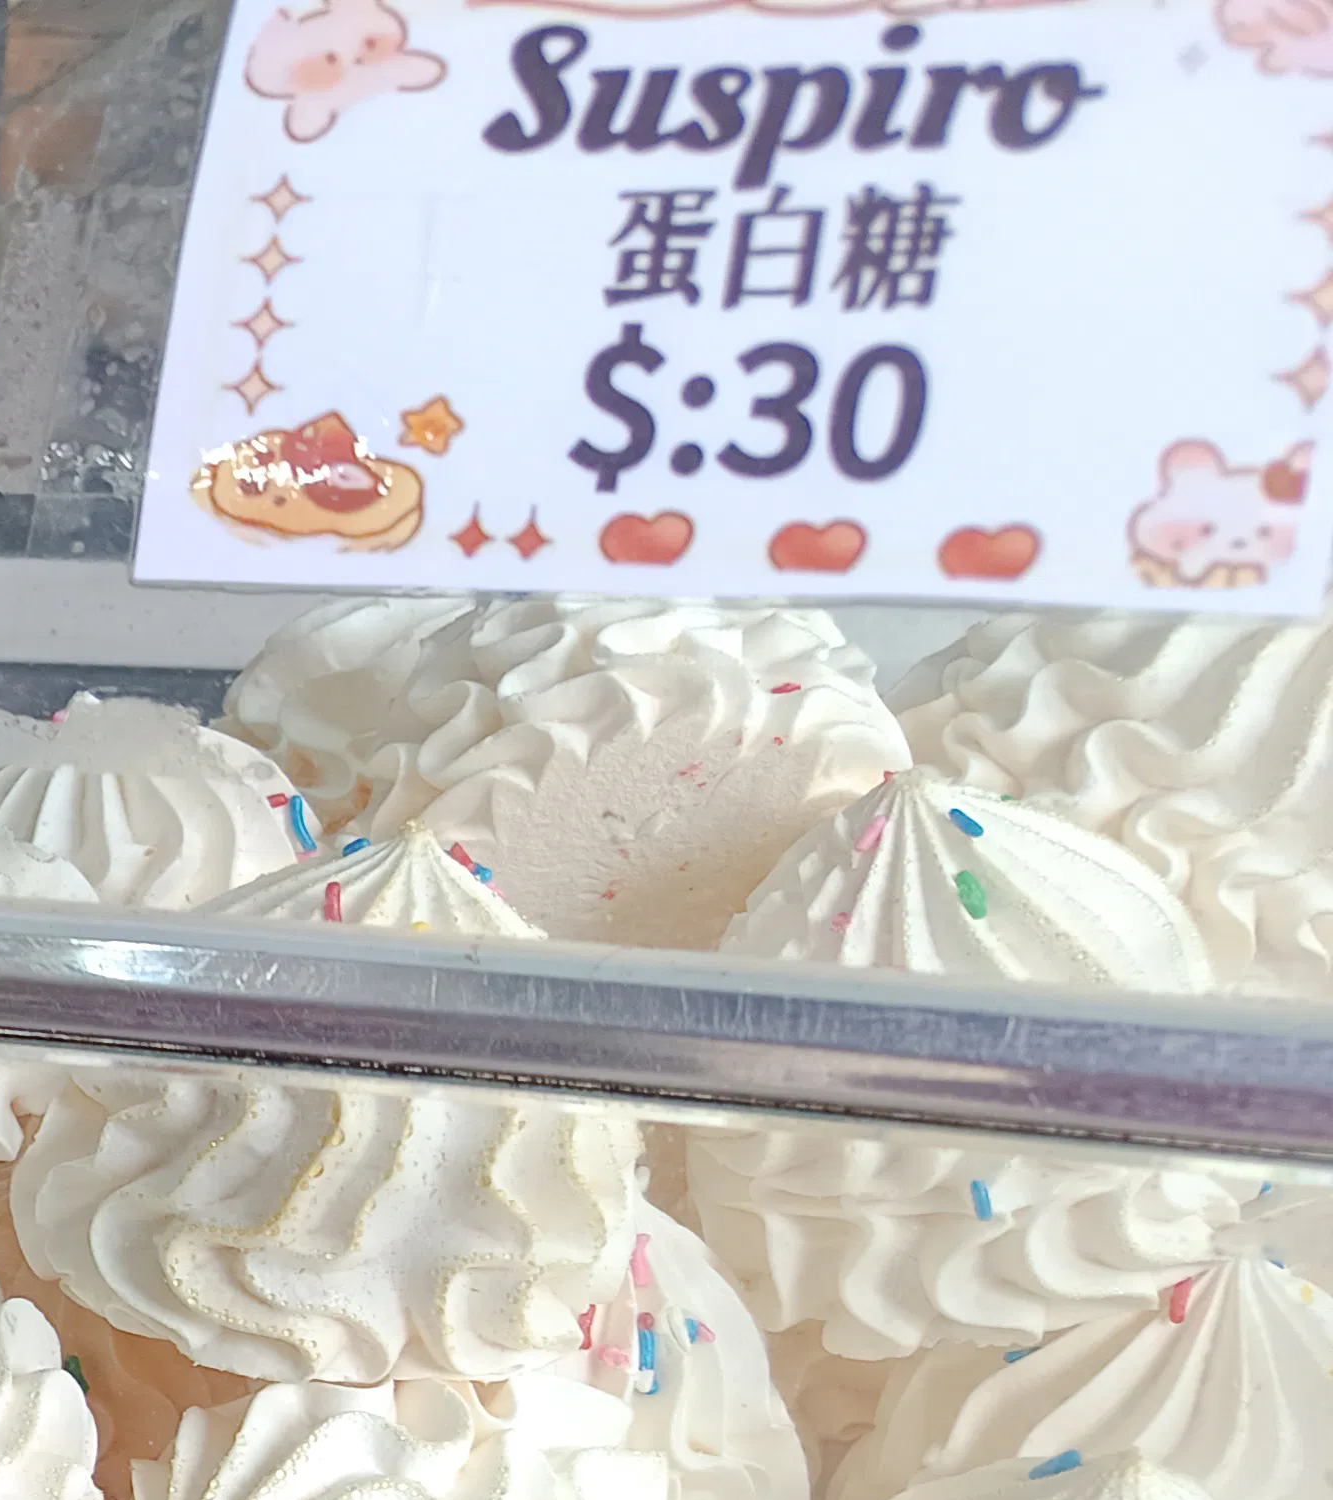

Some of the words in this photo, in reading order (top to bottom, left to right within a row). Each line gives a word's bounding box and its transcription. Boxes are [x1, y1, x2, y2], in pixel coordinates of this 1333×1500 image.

[482, 24, 1106, 190] Suspiro
[603, 184, 959, 311] 蛋白糖
[568, 322, 928, 492] $:30
